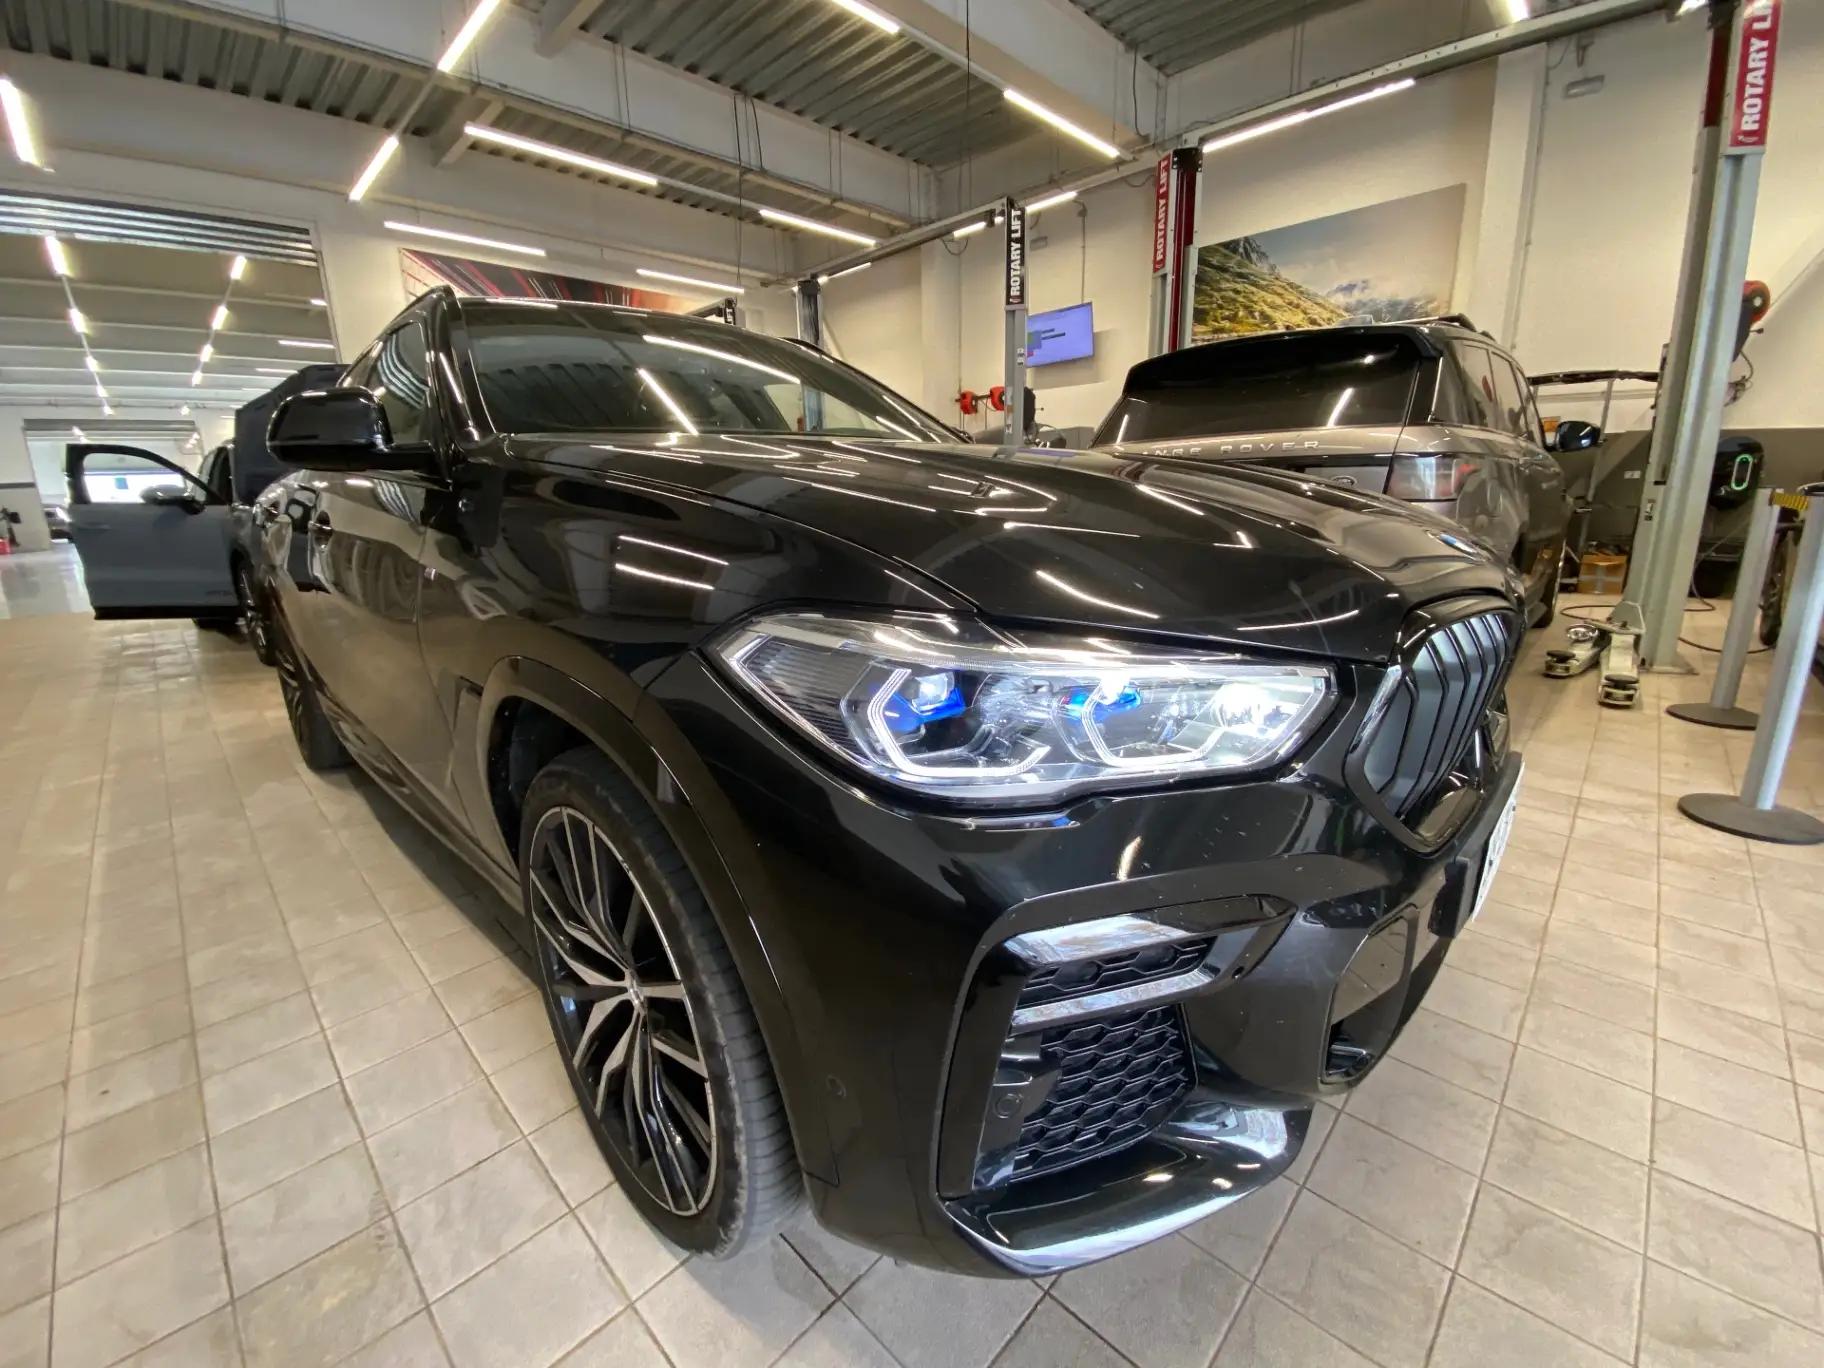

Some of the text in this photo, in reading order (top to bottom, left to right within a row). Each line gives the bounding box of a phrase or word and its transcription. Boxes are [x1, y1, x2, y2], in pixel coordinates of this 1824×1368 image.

[1740, 37, 1769, 131] ROTARY
[1010, 208, 1022, 296] ROTARY LIFT
[1156, 159, 1169, 261] ROTARY LIFT
[1220, 440, 1320, 455] ROVER
